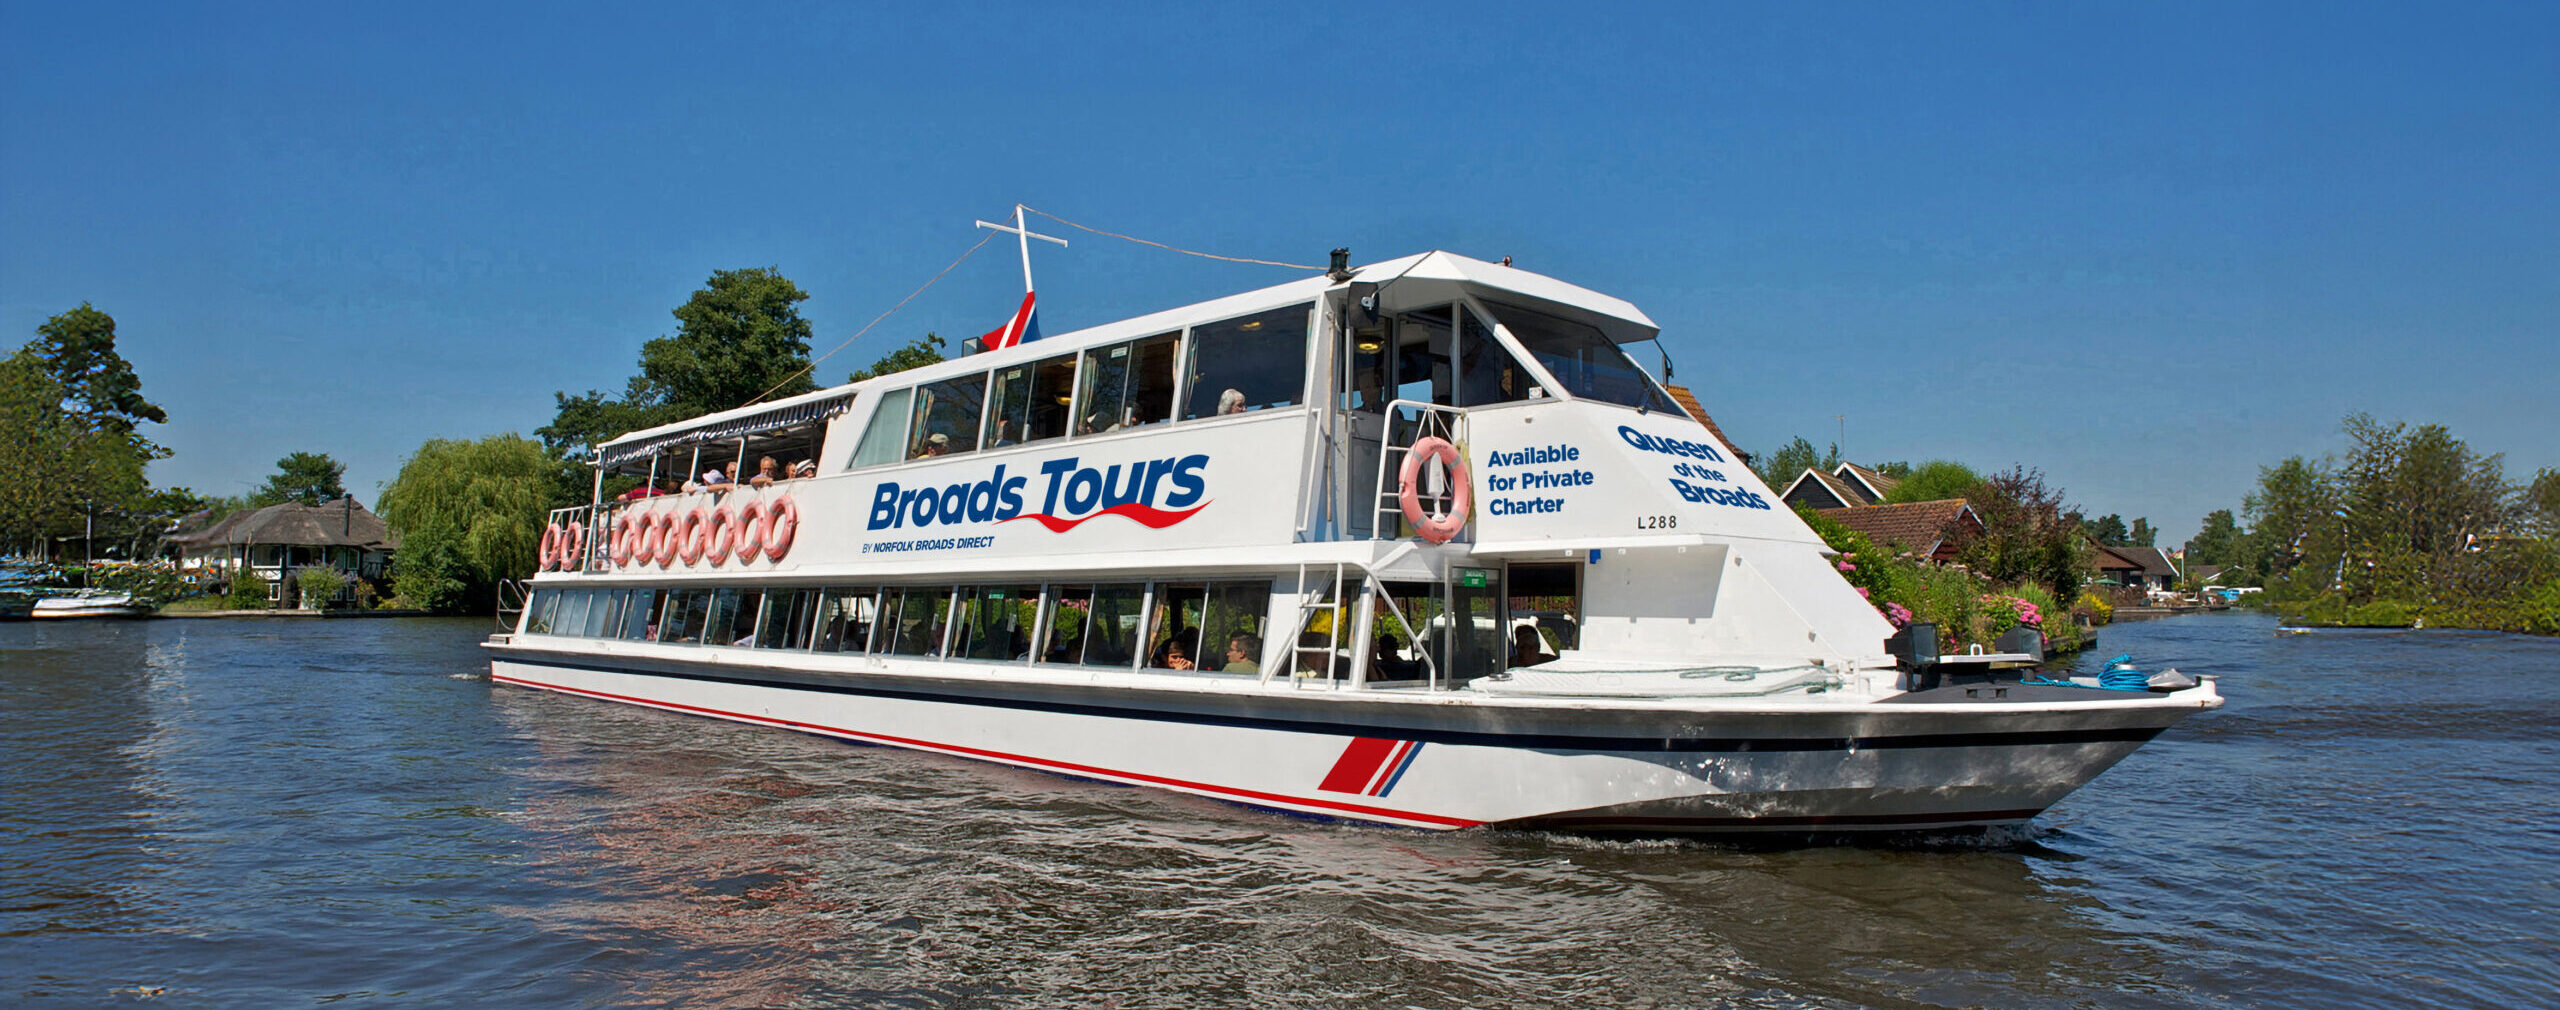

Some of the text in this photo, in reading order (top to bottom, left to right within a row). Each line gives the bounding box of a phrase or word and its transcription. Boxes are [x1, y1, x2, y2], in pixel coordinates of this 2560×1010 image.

[1487, 444, 1580, 467] Available
[1618, 425, 1726, 463] Queen
[1487, 474, 1517, 492] for
[1521, 469, 1594, 489] Private
[1674, 463, 1727, 482] of the
[866, 453, 1210, 531] Broads Tours
[1669, 478, 1771, 511] Broads
[1489, 497, 1565, 516] Charter
[1637, 515, 1677, 530] L288
[862, 535, 995, 554] BY NORFOLK BROADS DIRECT
